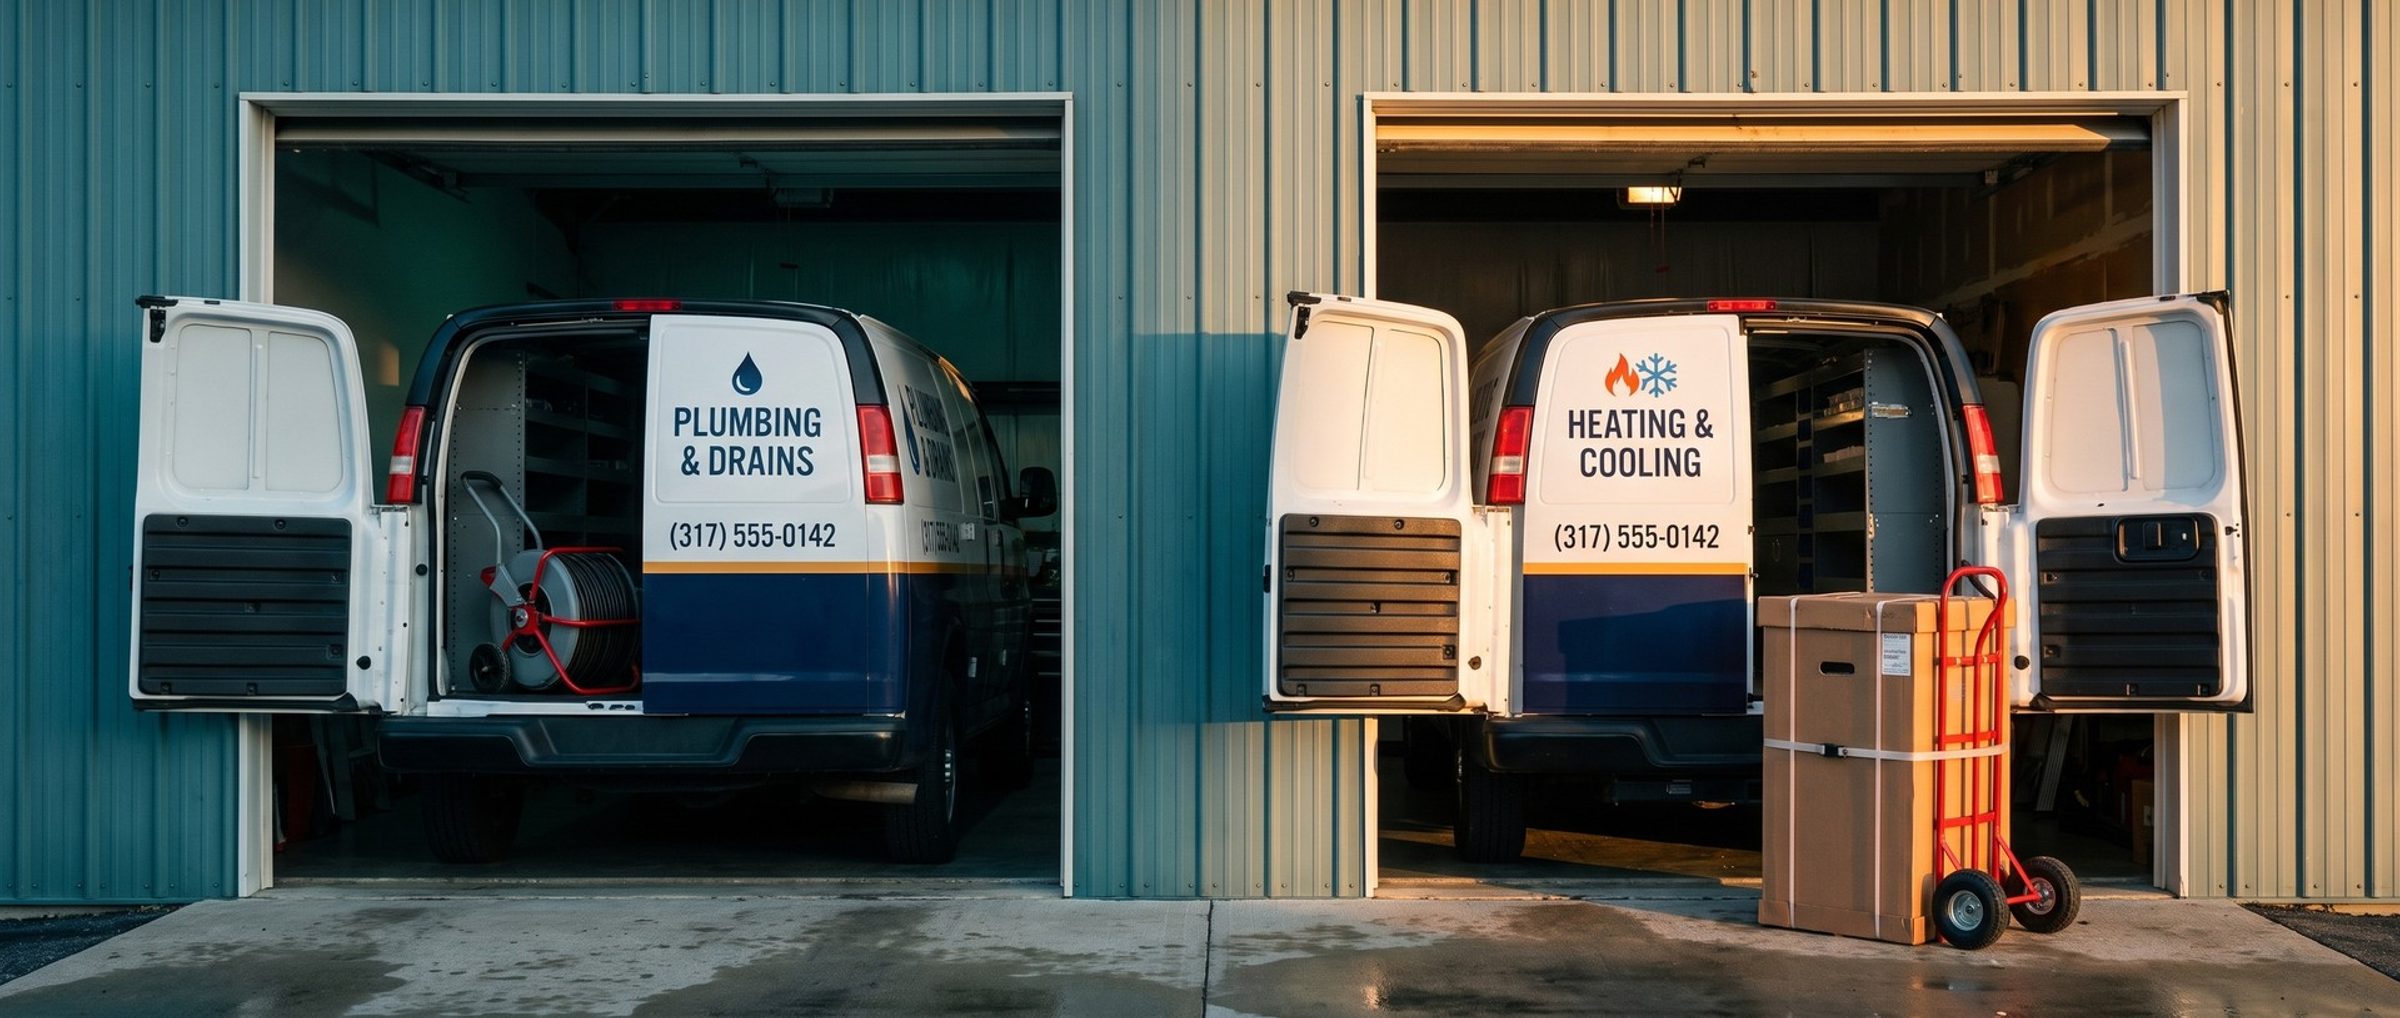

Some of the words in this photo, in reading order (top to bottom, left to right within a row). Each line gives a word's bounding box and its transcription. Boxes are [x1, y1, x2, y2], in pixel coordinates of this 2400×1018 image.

[674, 407, 821, 438] PLUMBING
[1568, 409, 1686, 439] HEATING
[1695, 409, 1714, 439] &
[681, 446, 700, 476] &
[709, 446, 814, 476] DRAINS
[1580, 448, 1701, 477] COOLING
[670, 522, 727, 551] (317)
[733, 523, 836, 548] 555-0142
[1555, 524, 1611, 552] (317)
[1618, 524, 1719, 549] 555-0142
